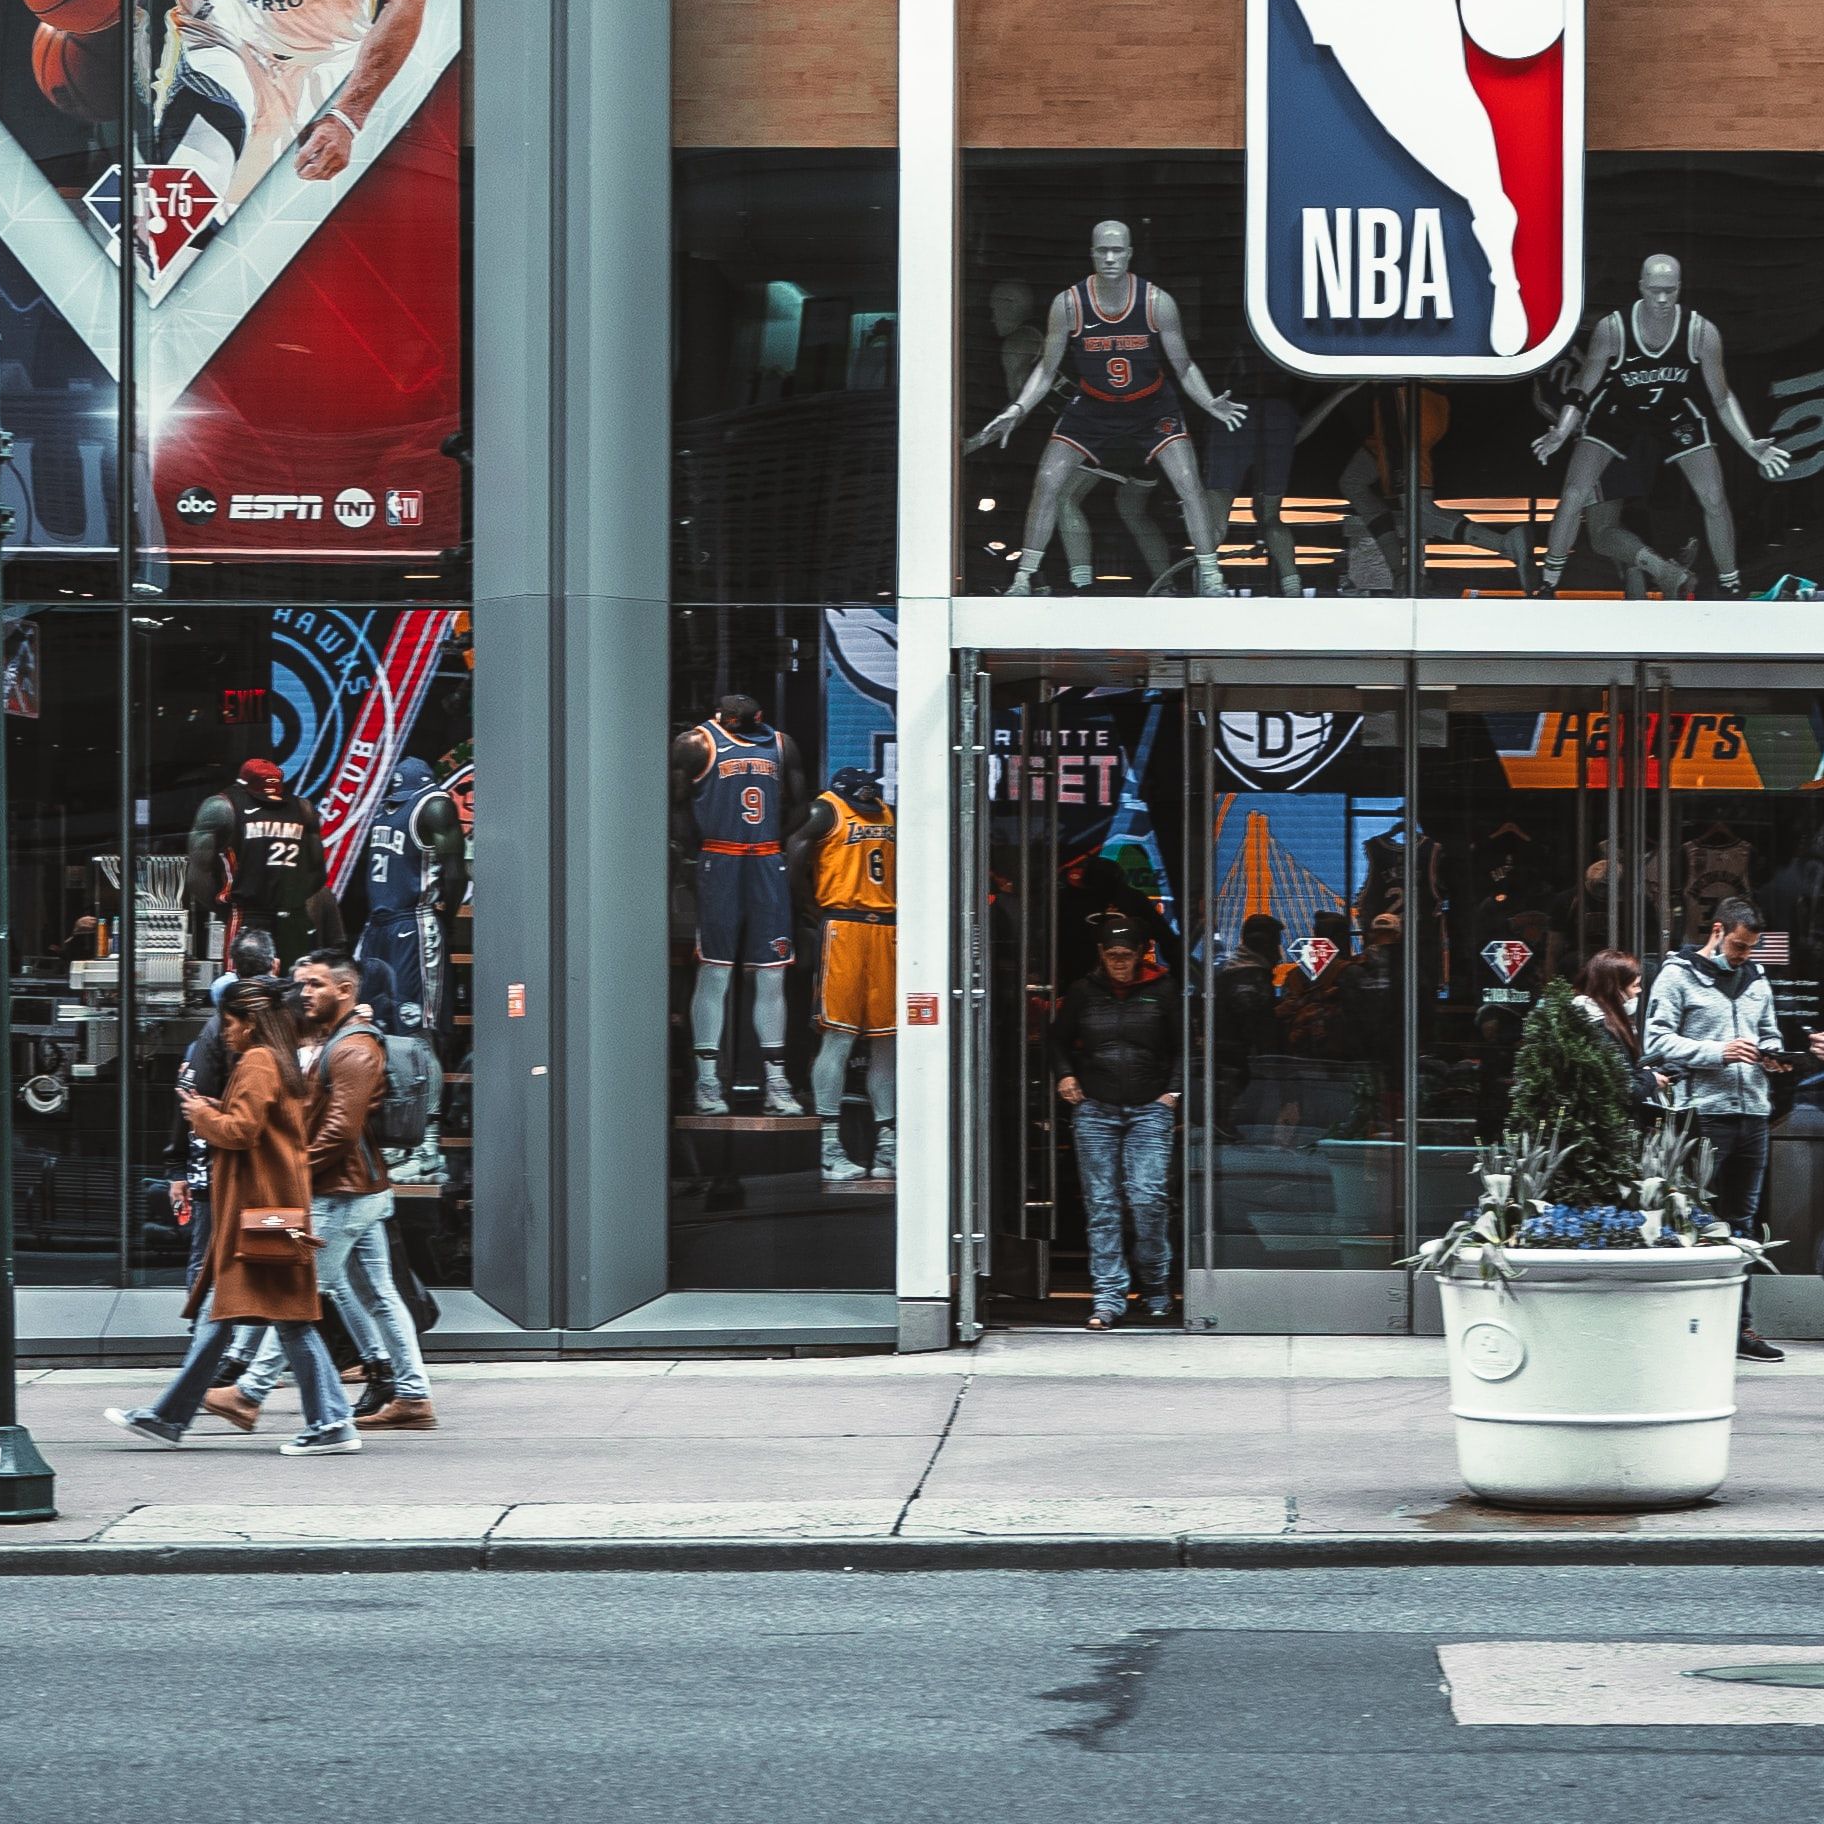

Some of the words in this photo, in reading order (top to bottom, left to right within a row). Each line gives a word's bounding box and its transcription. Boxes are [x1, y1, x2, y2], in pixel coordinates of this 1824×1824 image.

[165, 182, 193, 218] 75
[1301, 207, 1455, 320] NBA
[1107, 357, 1133, 388] 9
[1620, 367, 1690, 387] BROOKLYN
[1649, 387, 1664, 404] 7
[176, 495, 218, 513] abc
[228, 494, 324, 521] ESPN
[334, 501, 375, 518] TNT
[272, 608, 372, 696] HAWKS
[741, 786, 766, 825] 9
[245, 821, 304, 840] MIAMI
[266, 842, 300, 867] 22
